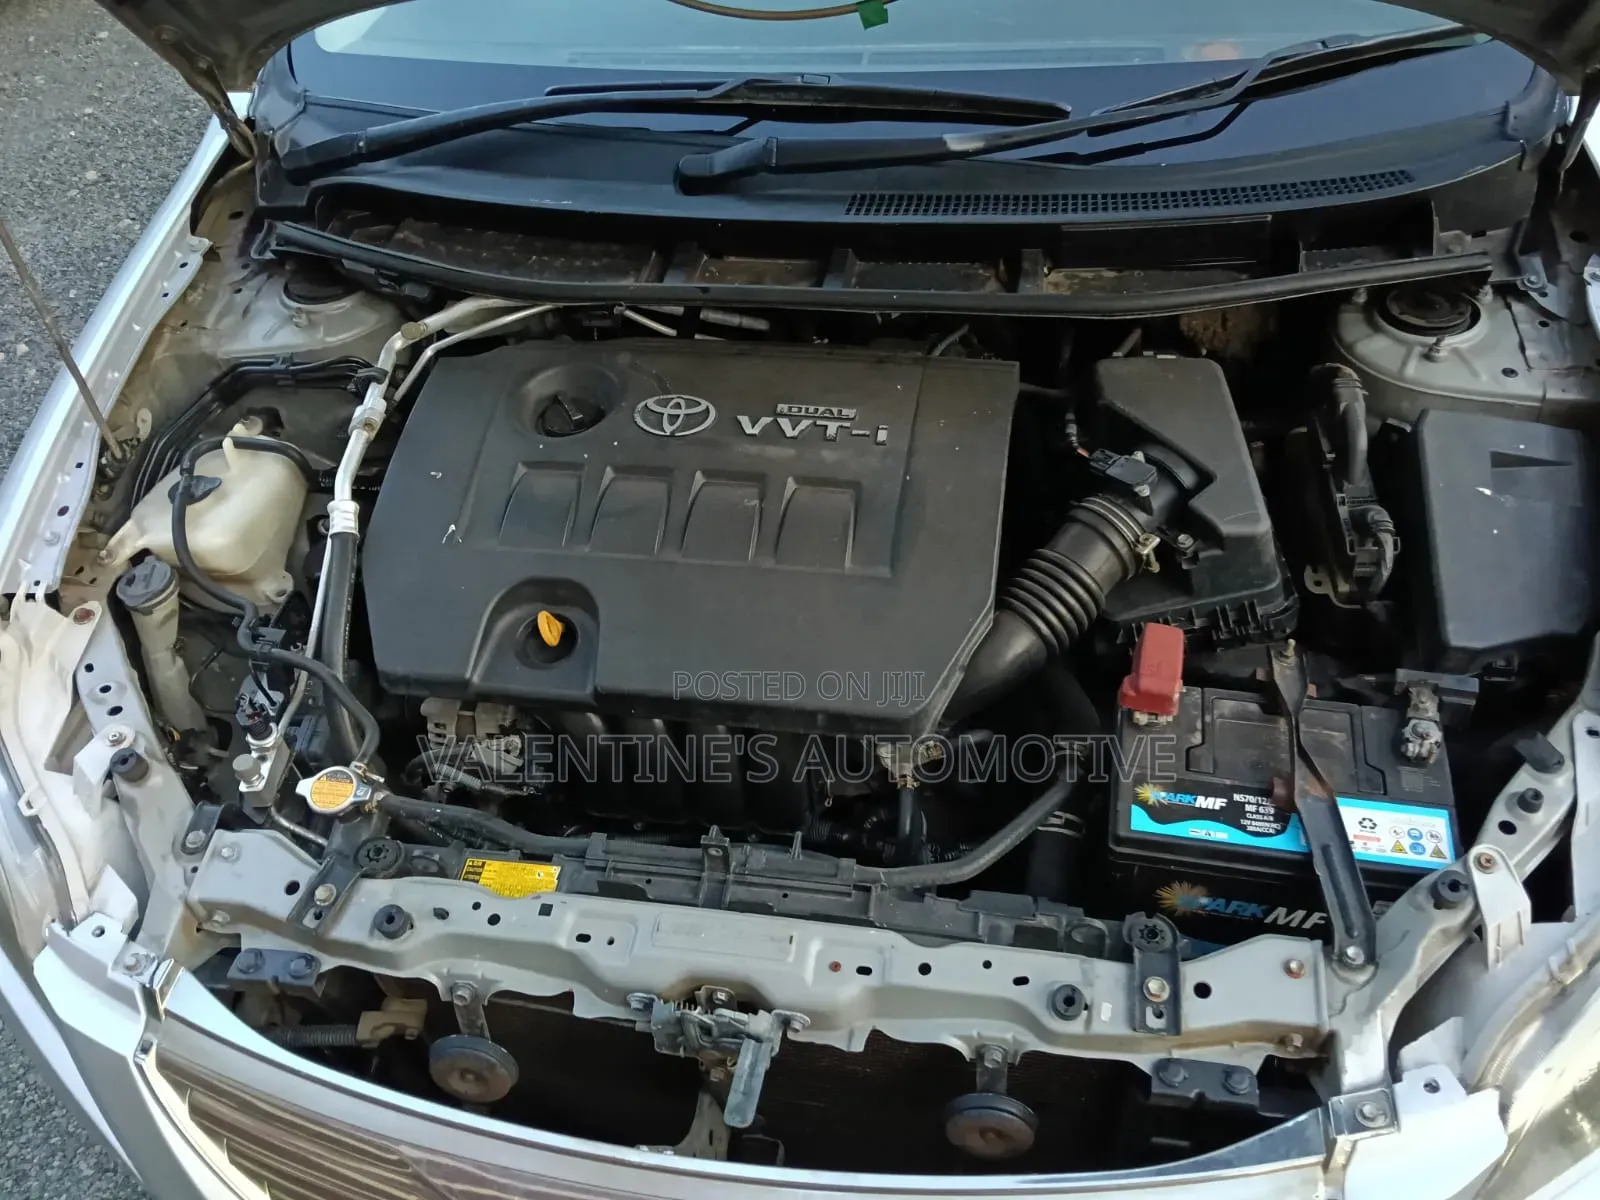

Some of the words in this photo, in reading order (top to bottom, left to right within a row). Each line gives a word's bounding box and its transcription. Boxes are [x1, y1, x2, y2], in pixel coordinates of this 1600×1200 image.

[785, 404, 852, 418] DUAL
[736, 415, 889, 445] VVT-i
[1244, 803, 1258, 813] MF
[1263, 906, 1329, 929] MF
